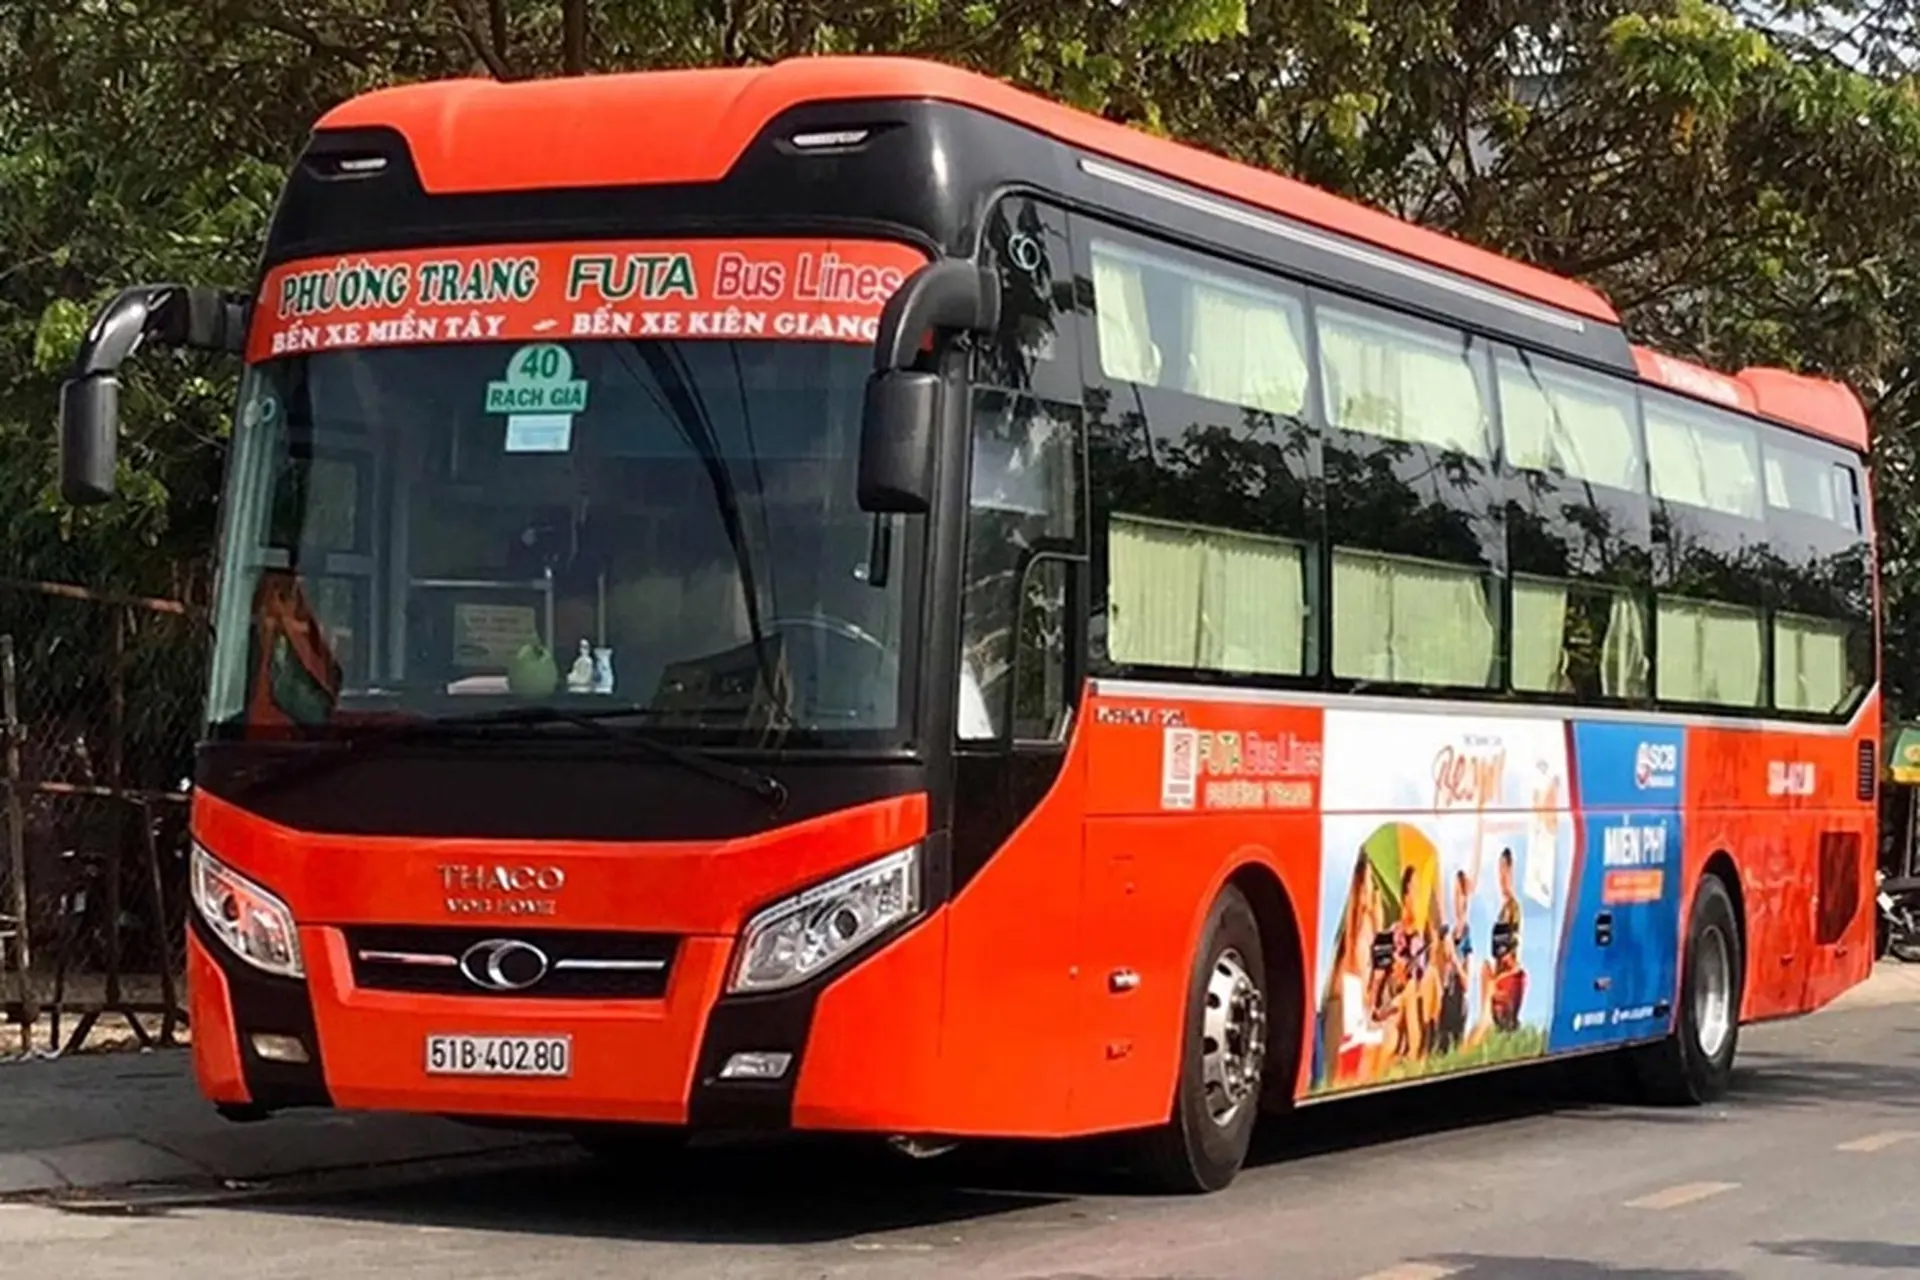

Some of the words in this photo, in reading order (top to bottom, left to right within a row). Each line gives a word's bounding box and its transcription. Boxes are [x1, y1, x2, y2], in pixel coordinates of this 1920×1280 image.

[278, 258, 411, 319] PHƯƠNG
[416, 256, 540, 304] TRANG
[565, 252, 698, 303] FUTA
[712, 252, 786, 301] Bus
[794, 252, 904, 305] Lines
[271, 318, 320, 354] BẾN
[323, 322, 362, 346] XE
[444, 310, 506, 340] TÂY
[572, 301, 635, 335] BẾN
[639, 311, 681, 335] XE
[687, 304, 767, 336] KIÊN
[520, 347, 560, 379] 40
[438, 864, 565, 891] THACO
